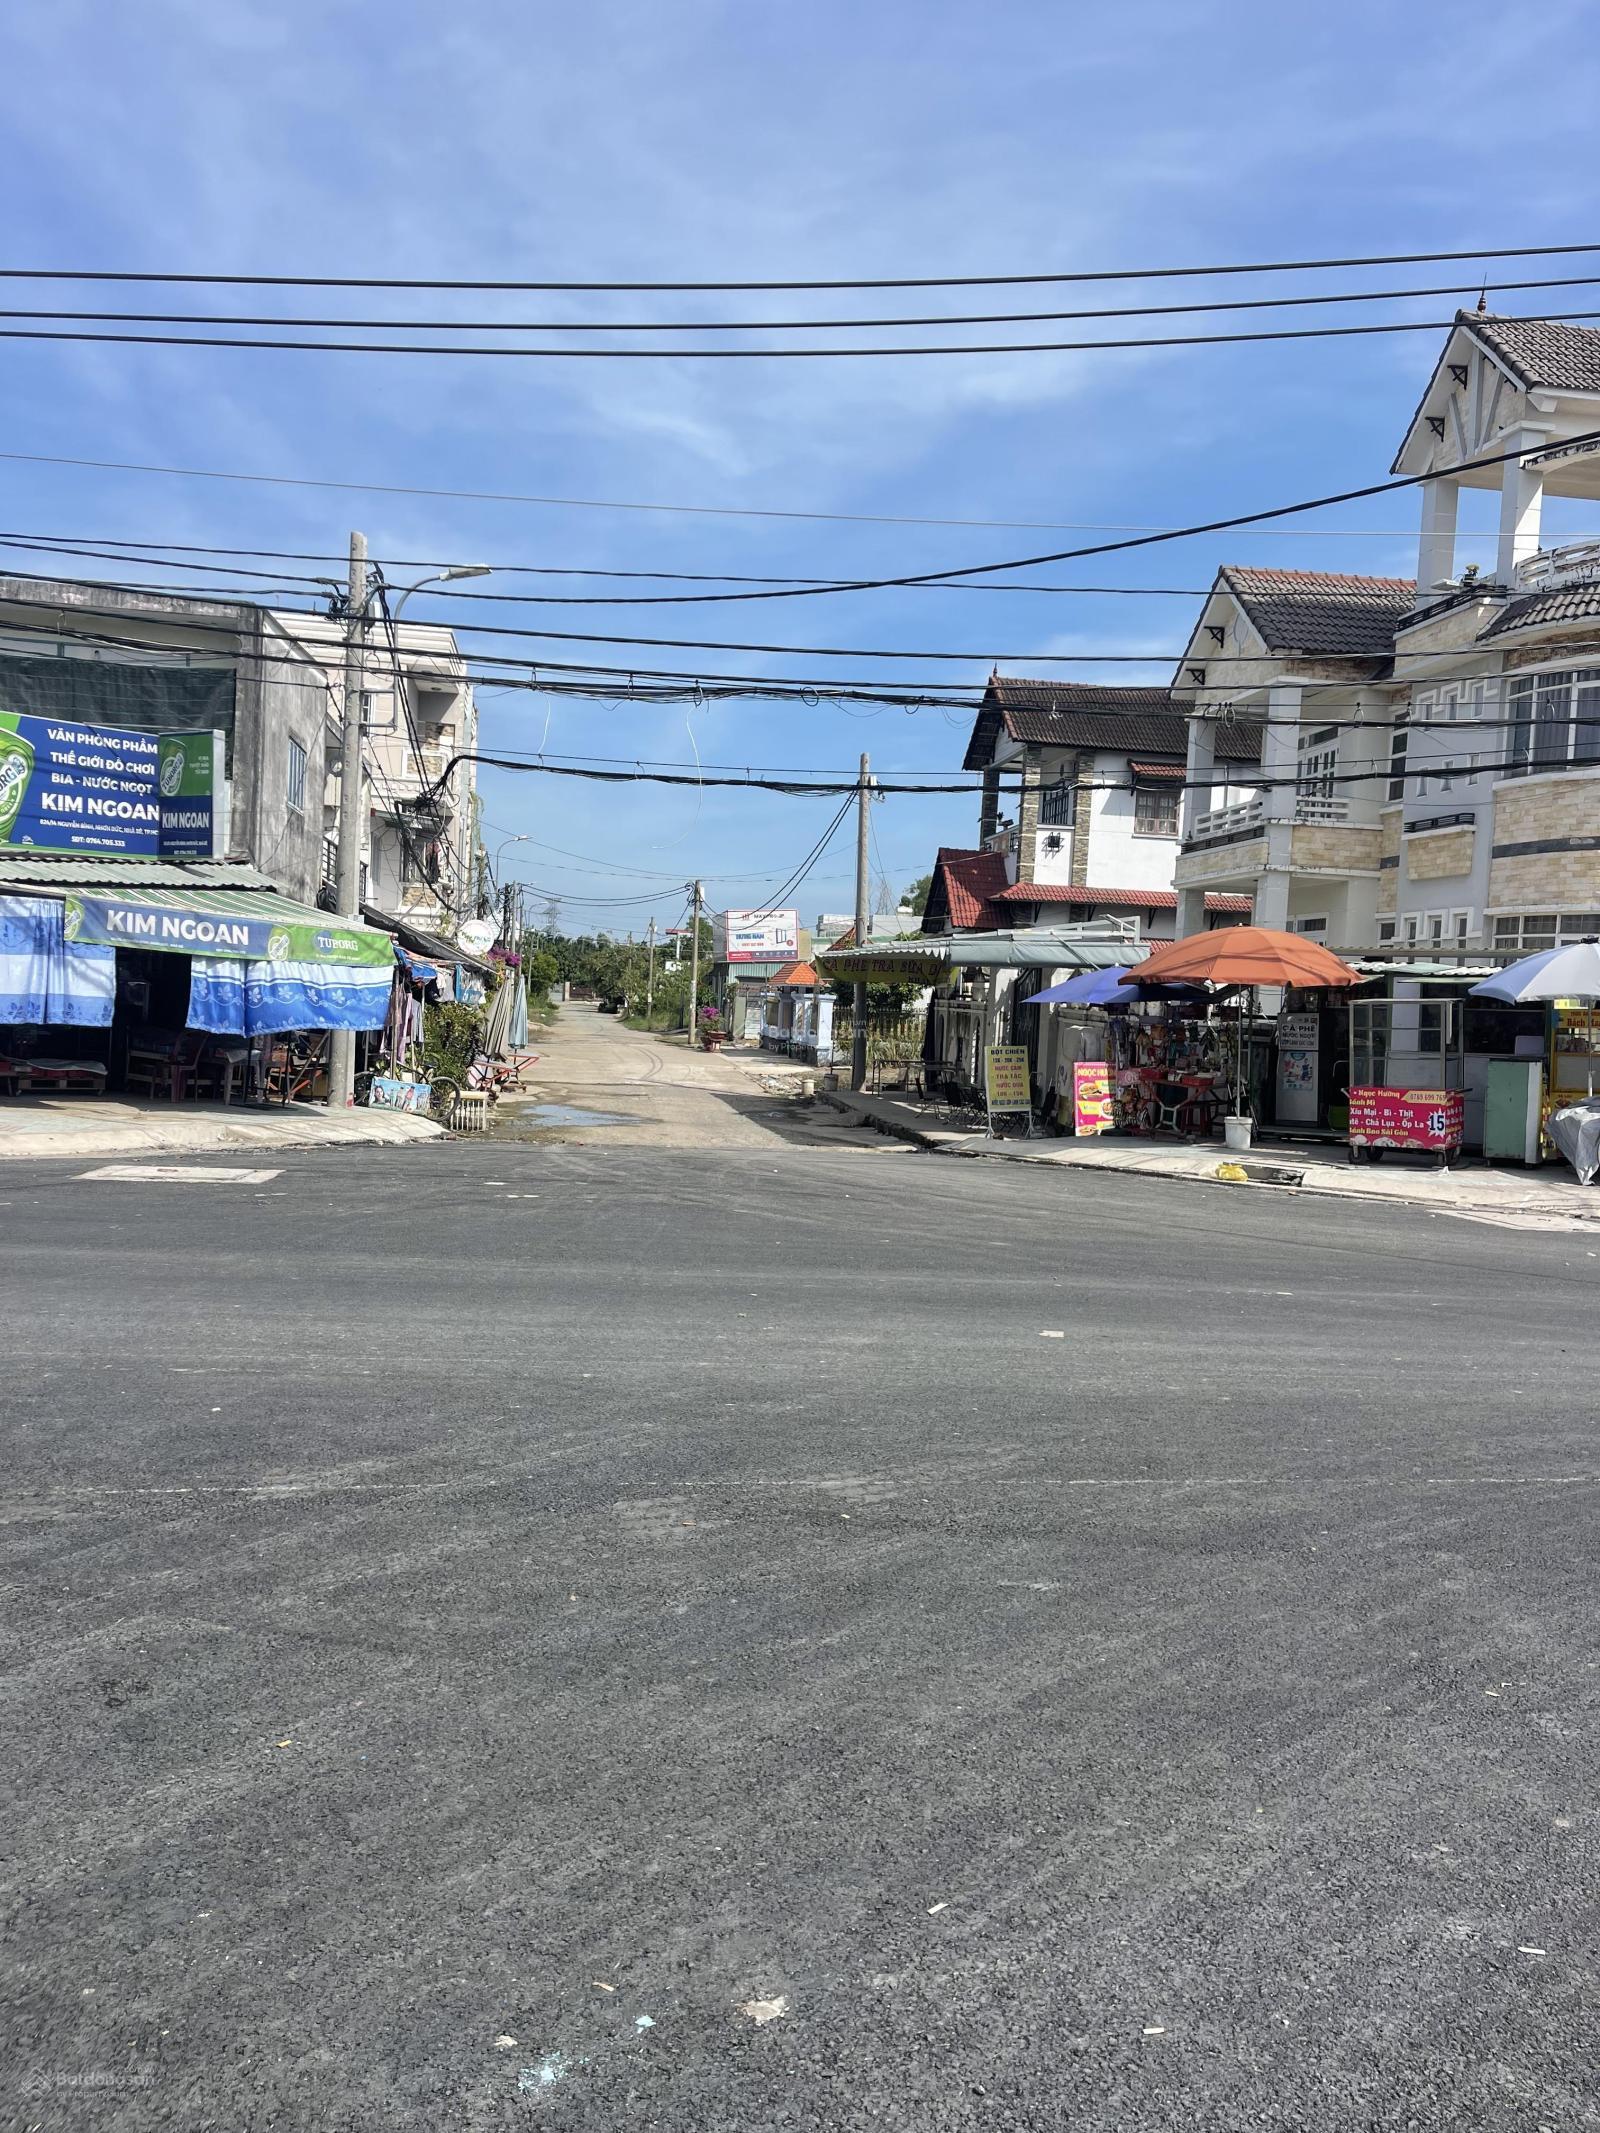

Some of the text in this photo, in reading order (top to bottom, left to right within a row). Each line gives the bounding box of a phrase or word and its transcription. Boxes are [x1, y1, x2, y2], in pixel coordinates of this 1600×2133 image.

[48, 728, 75, 742] VĂN
[77, 734, 120, 749] PHÒNG
[50, 750, 155, 775] THẾ GIỚI ĐỒ CHƠI
[52, 773, 152, 796] BIA NƯỚC NGỌT
[42, 792, 160, 821] KIM NGOAN
[162, 812, 210, 828] KIM NGOAN
[106, 909, 156, 936] KIM
[162, 916, 249, 946] NGOAN
[317, 936, 358, 951] TUBORG
[1358, 1089, 1376, 1097] Ngọc
[1430, 1115, 1444, 1131] 15
